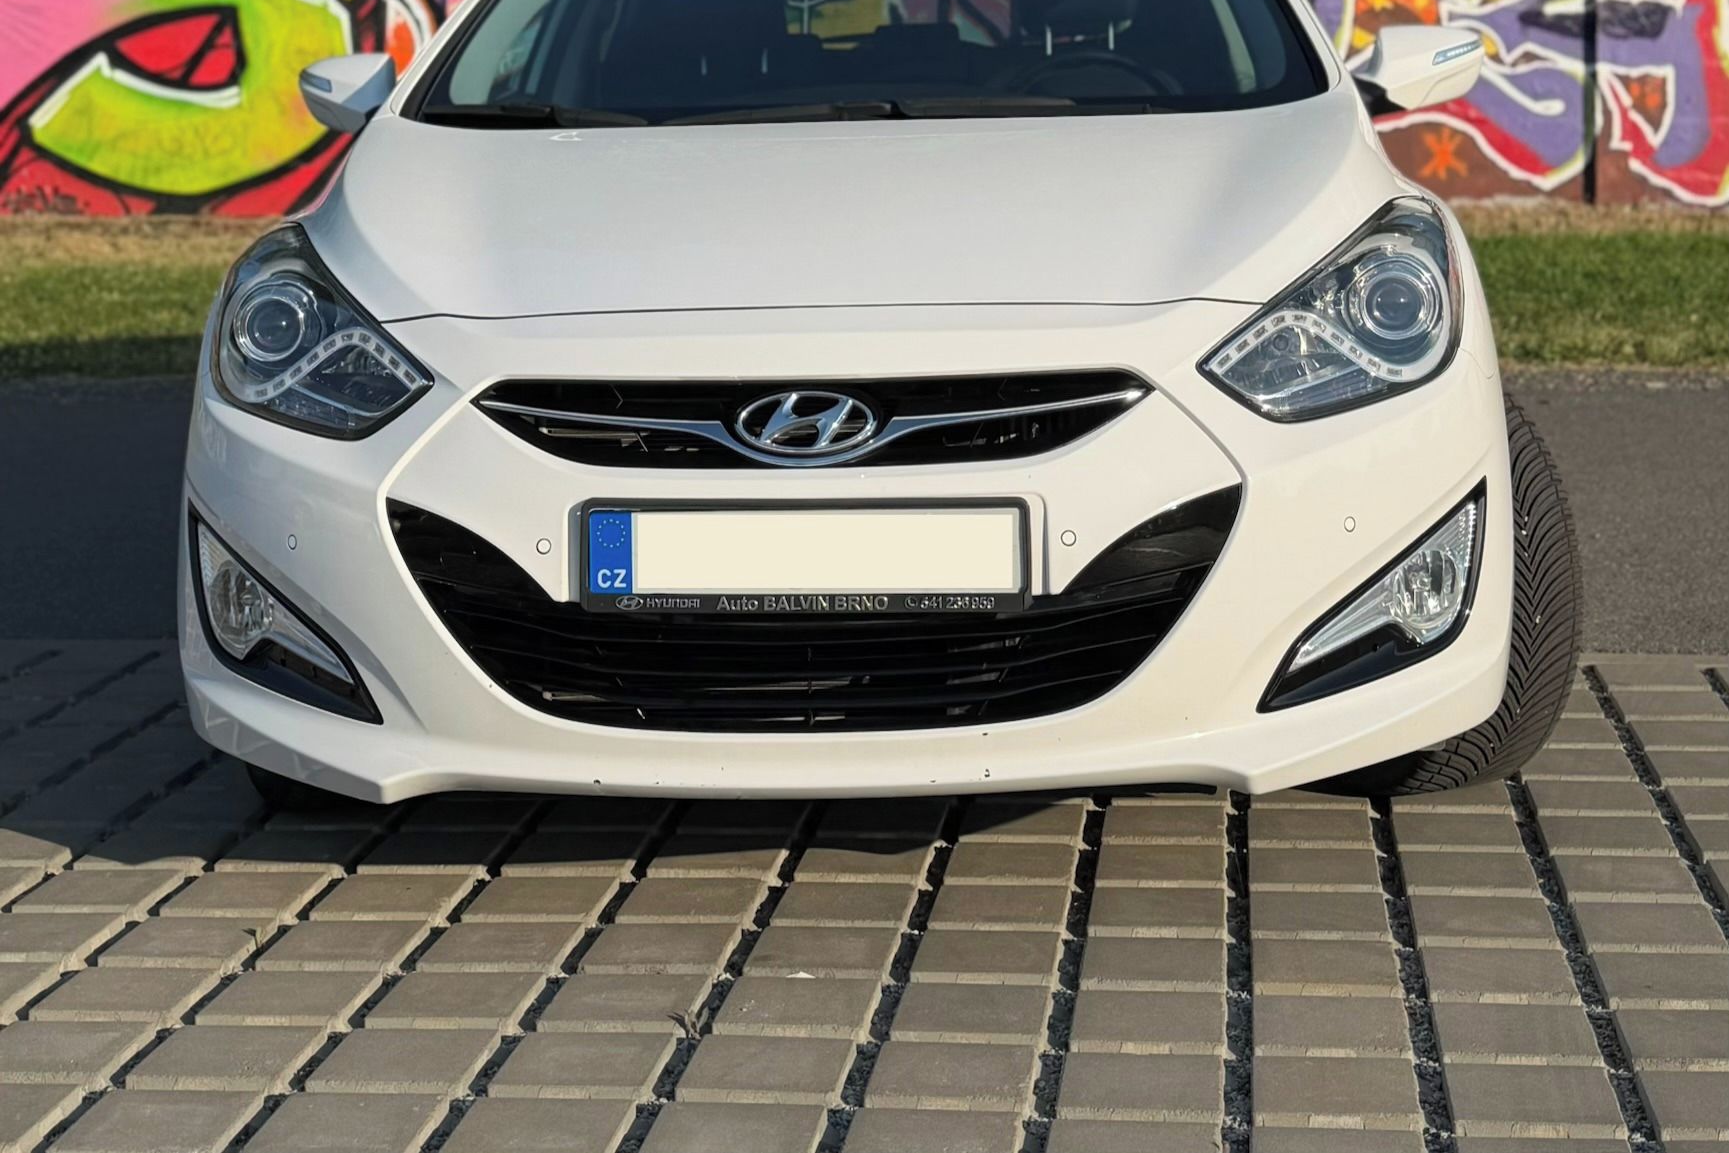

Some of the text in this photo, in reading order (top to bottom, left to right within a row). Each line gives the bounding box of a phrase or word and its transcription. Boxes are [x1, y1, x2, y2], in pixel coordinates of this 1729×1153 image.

[596, 568, 627, 588] CZ
[646, 597, 701, 609] HYUNDAI
[716, 596, 759, 611] Auto
[763, 595, 830, 611] BALVIN
[834, 596, 889, 611] BRNO
